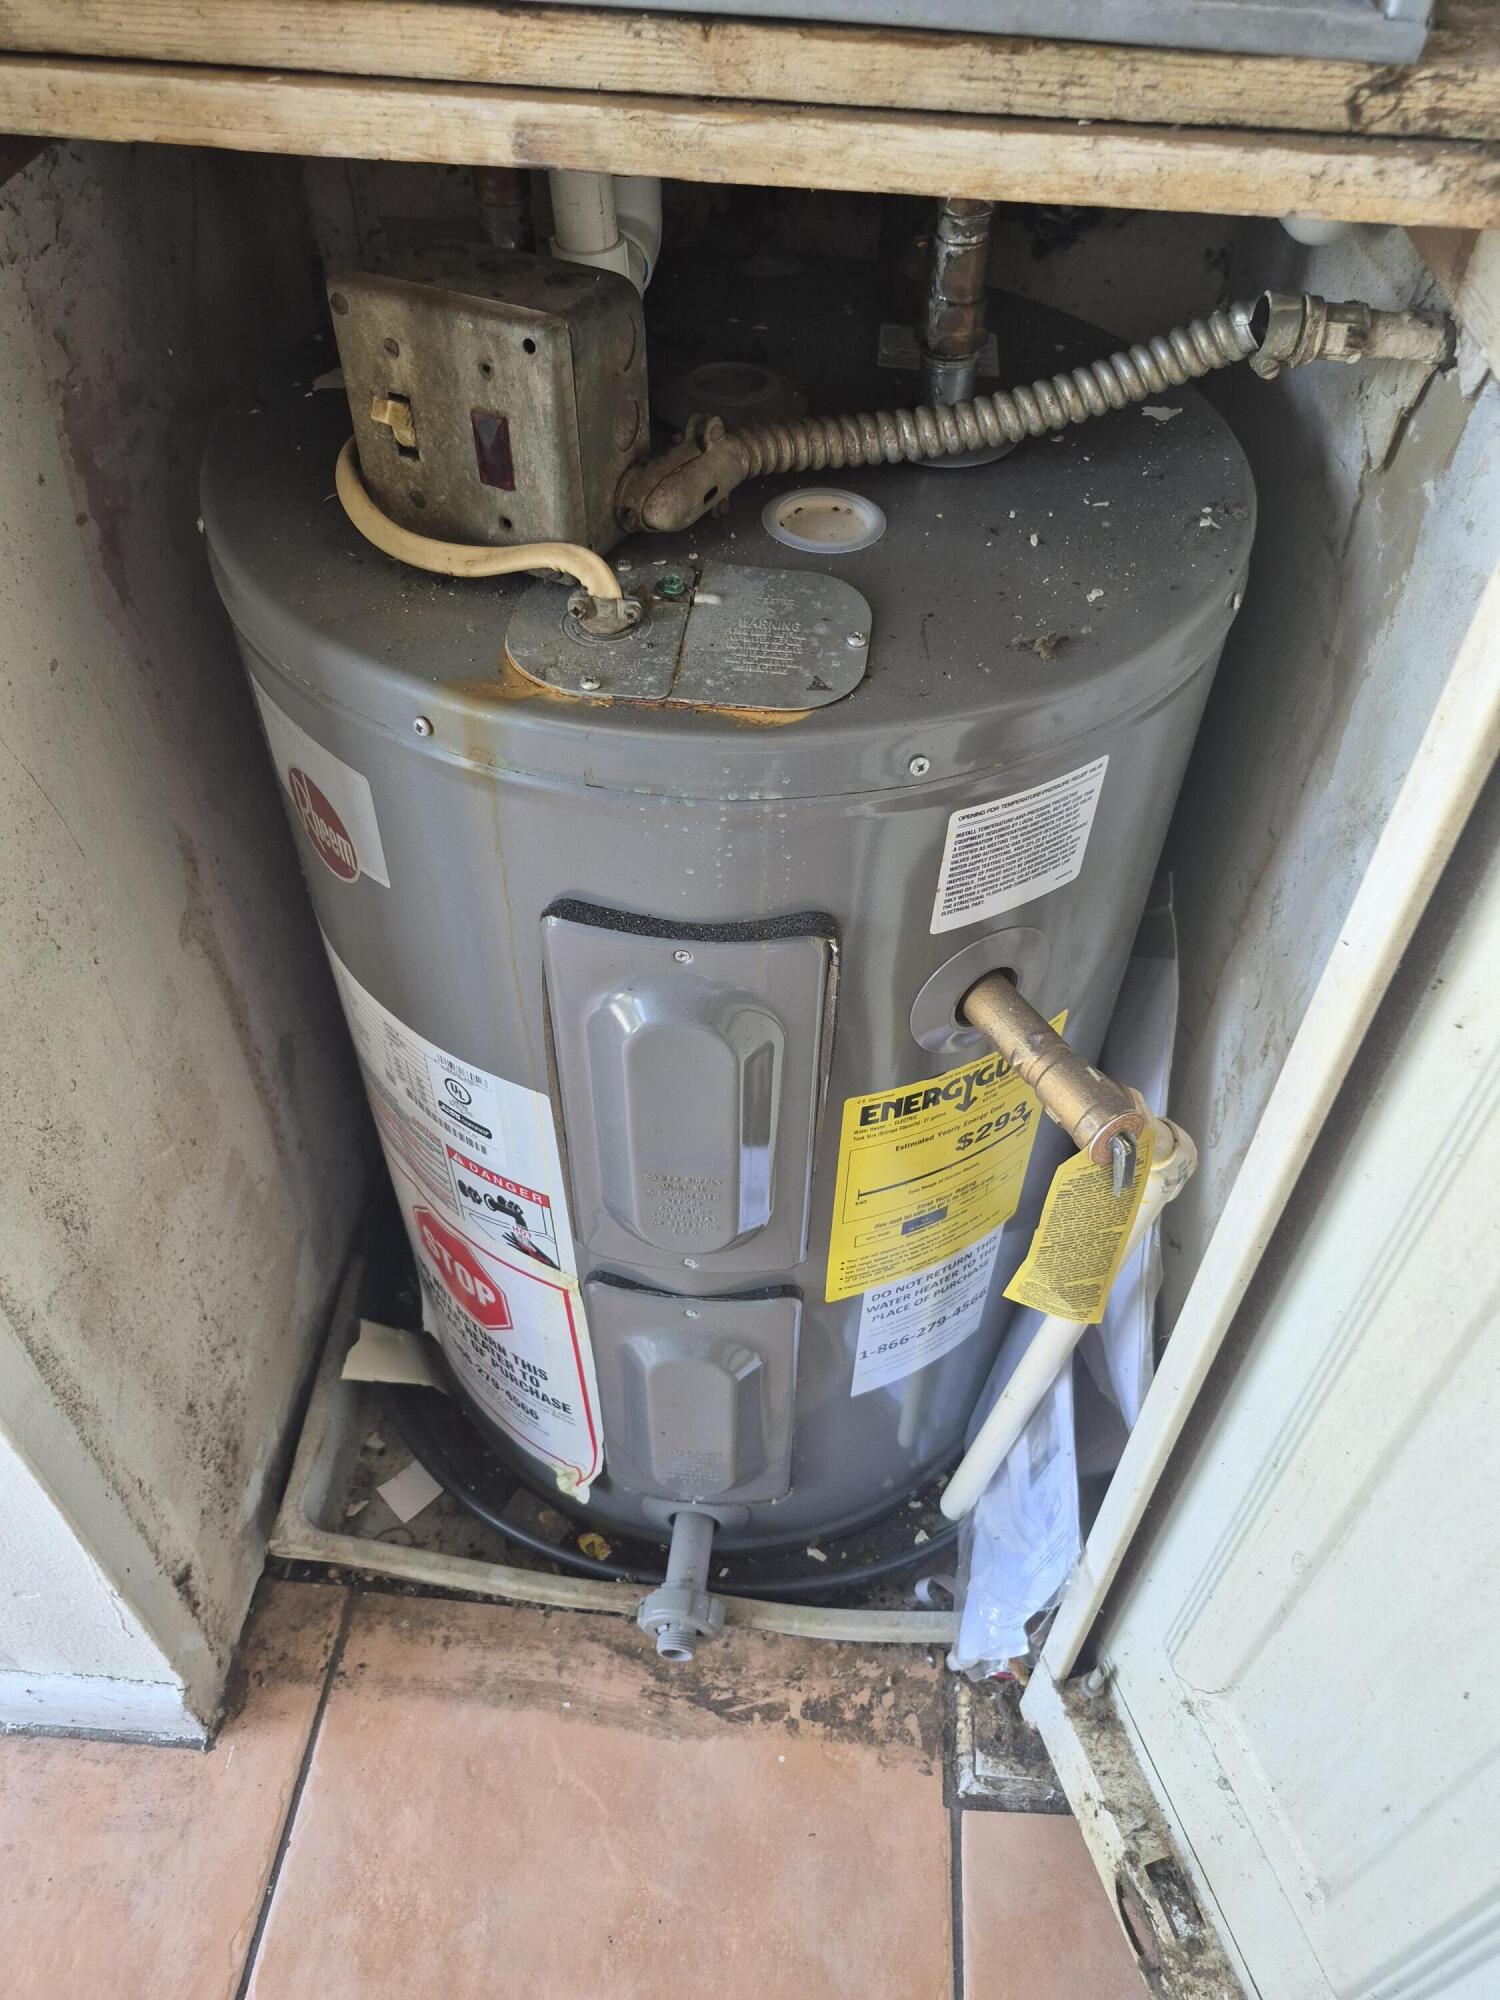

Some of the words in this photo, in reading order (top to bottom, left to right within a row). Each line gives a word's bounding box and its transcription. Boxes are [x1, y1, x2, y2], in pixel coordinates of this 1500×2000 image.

[291, 767, 358, 872] Rheem
[954, 834, 984, 845] EQUIPMENT
[955, 829, 976, 838] INSTALL
[958, 810, 985, 821] OPENING
[860, 1057, 1011, 1127] ENERGYGU
[893, 1112, 918, 1125] ELECTRIC
[894, 1132, 934, 1153] Estimated
[936, 1121, 961, 1140] Yearly
[962, 1108, 988, 1128] Energy
[989, 1099, 1006, 1114] Cost
[955, 1101, 1028, 1151] $293
[469, 1160, 544, 1205] DANGER
[422, 1225, 497, 1305] STOP
[865, 1291, 910, 1314] WATER
[914, 1268, 958, 1297] HEATER
[960, 1257, 976, 1273] TO
[871, 1288, 892, 1302] DO
[894, 1276, 922, 1294] NOT
[925, 1250, 972, 1282] RETURN
[871, 1301, 910, 1323] PLACE
[913, 1292, 931, 1307] OF
[932, 1257, 989, 1298] PURCHASE
[858, 1284, 988, 1361] 1-866-279-4566
[490, 1356, 573, 1415] PURCHASE
[510, 1351, 549, 1382] THIS
[519, 1368, 540, 1389] TO
